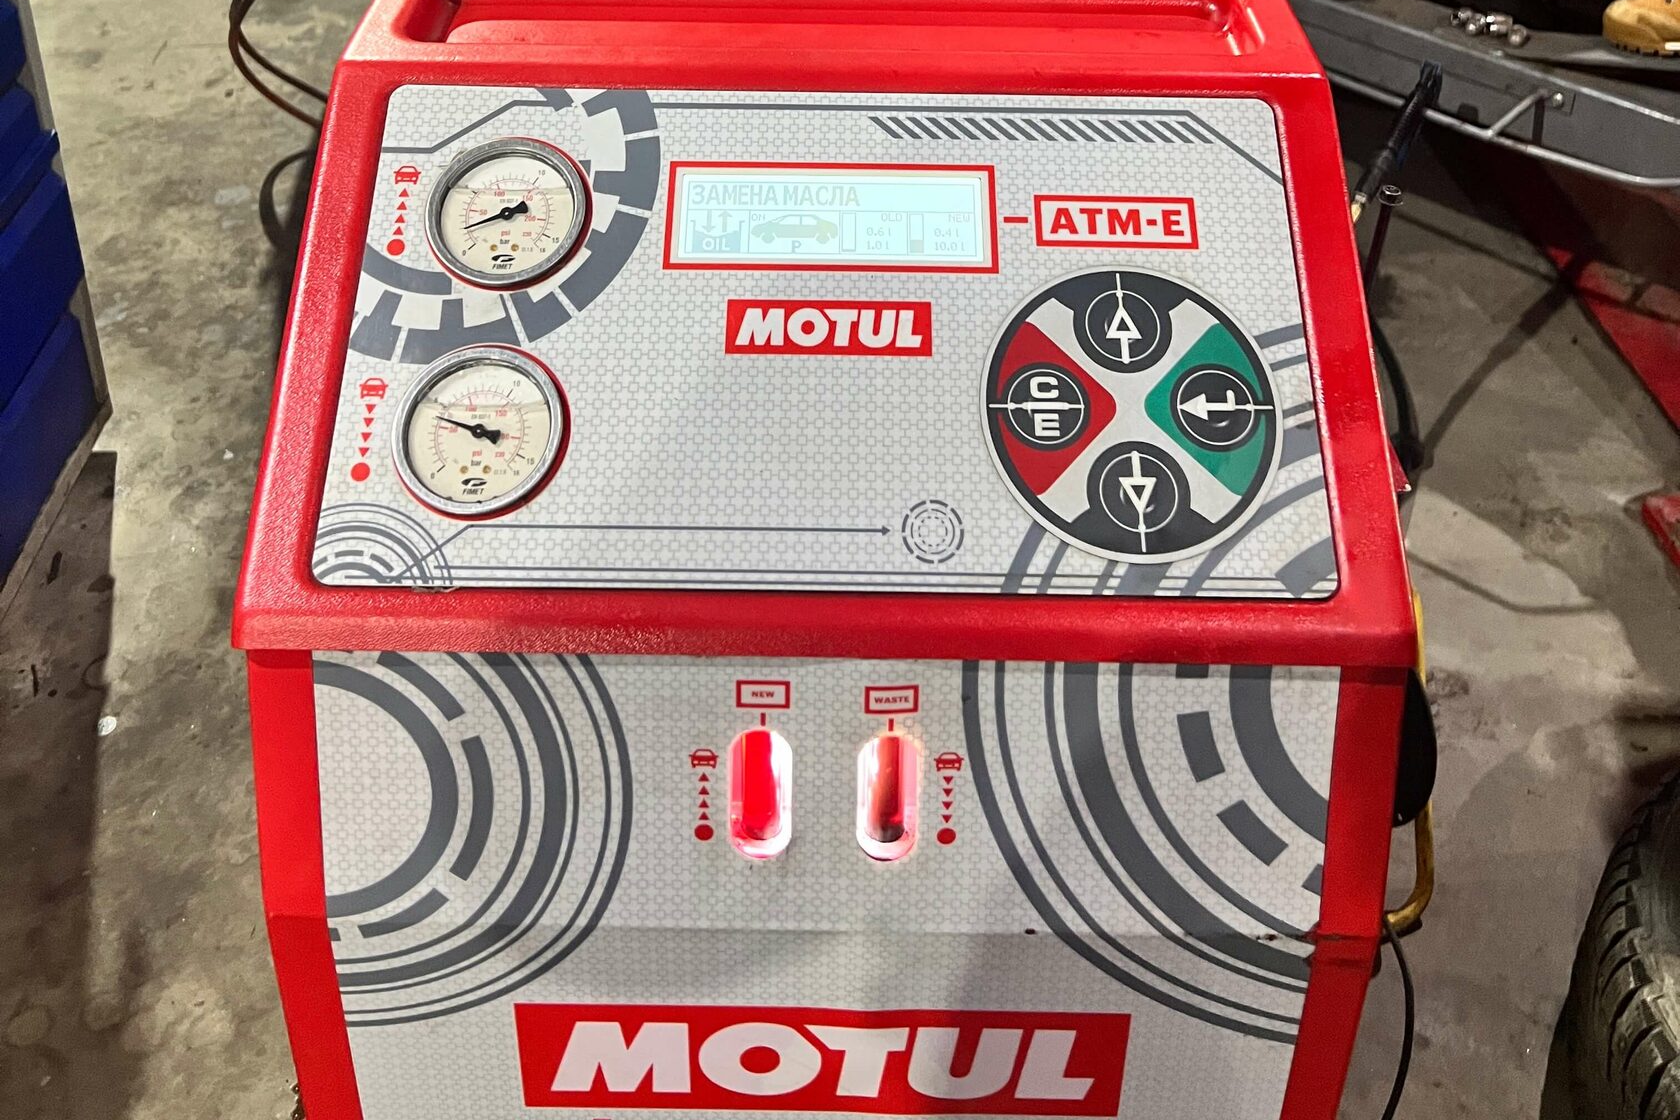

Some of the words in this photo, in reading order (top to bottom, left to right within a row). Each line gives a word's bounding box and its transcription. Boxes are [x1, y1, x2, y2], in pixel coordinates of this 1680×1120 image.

[691, 183, 779, 206] ЗАМЕНА
[783, 184, 861, 207] МАСЛА
[524, 214, 537, 222] 200
[881, 212, 903, 222] OLD
[947, 213, 971, 223] NEW
[1049, 206, 1186, 237] ATM-E
[702, 238, 731, 251] OIL
[791, 240, 802, 254] P
[734, 307, 925, 349] MOTUL
[1029, 376, 1060, 400] C
[1034, 413, 1061, 437] E
[472, 449, 483, 458] psi
[470, 459, 482, 467] bar
[462, 487, 485, 496] FIMET
[751, 690, 776, 699] NEW
[873, 695, 911, 705] WASTE
[550, 1020, 1096, 1101] MOTUL
